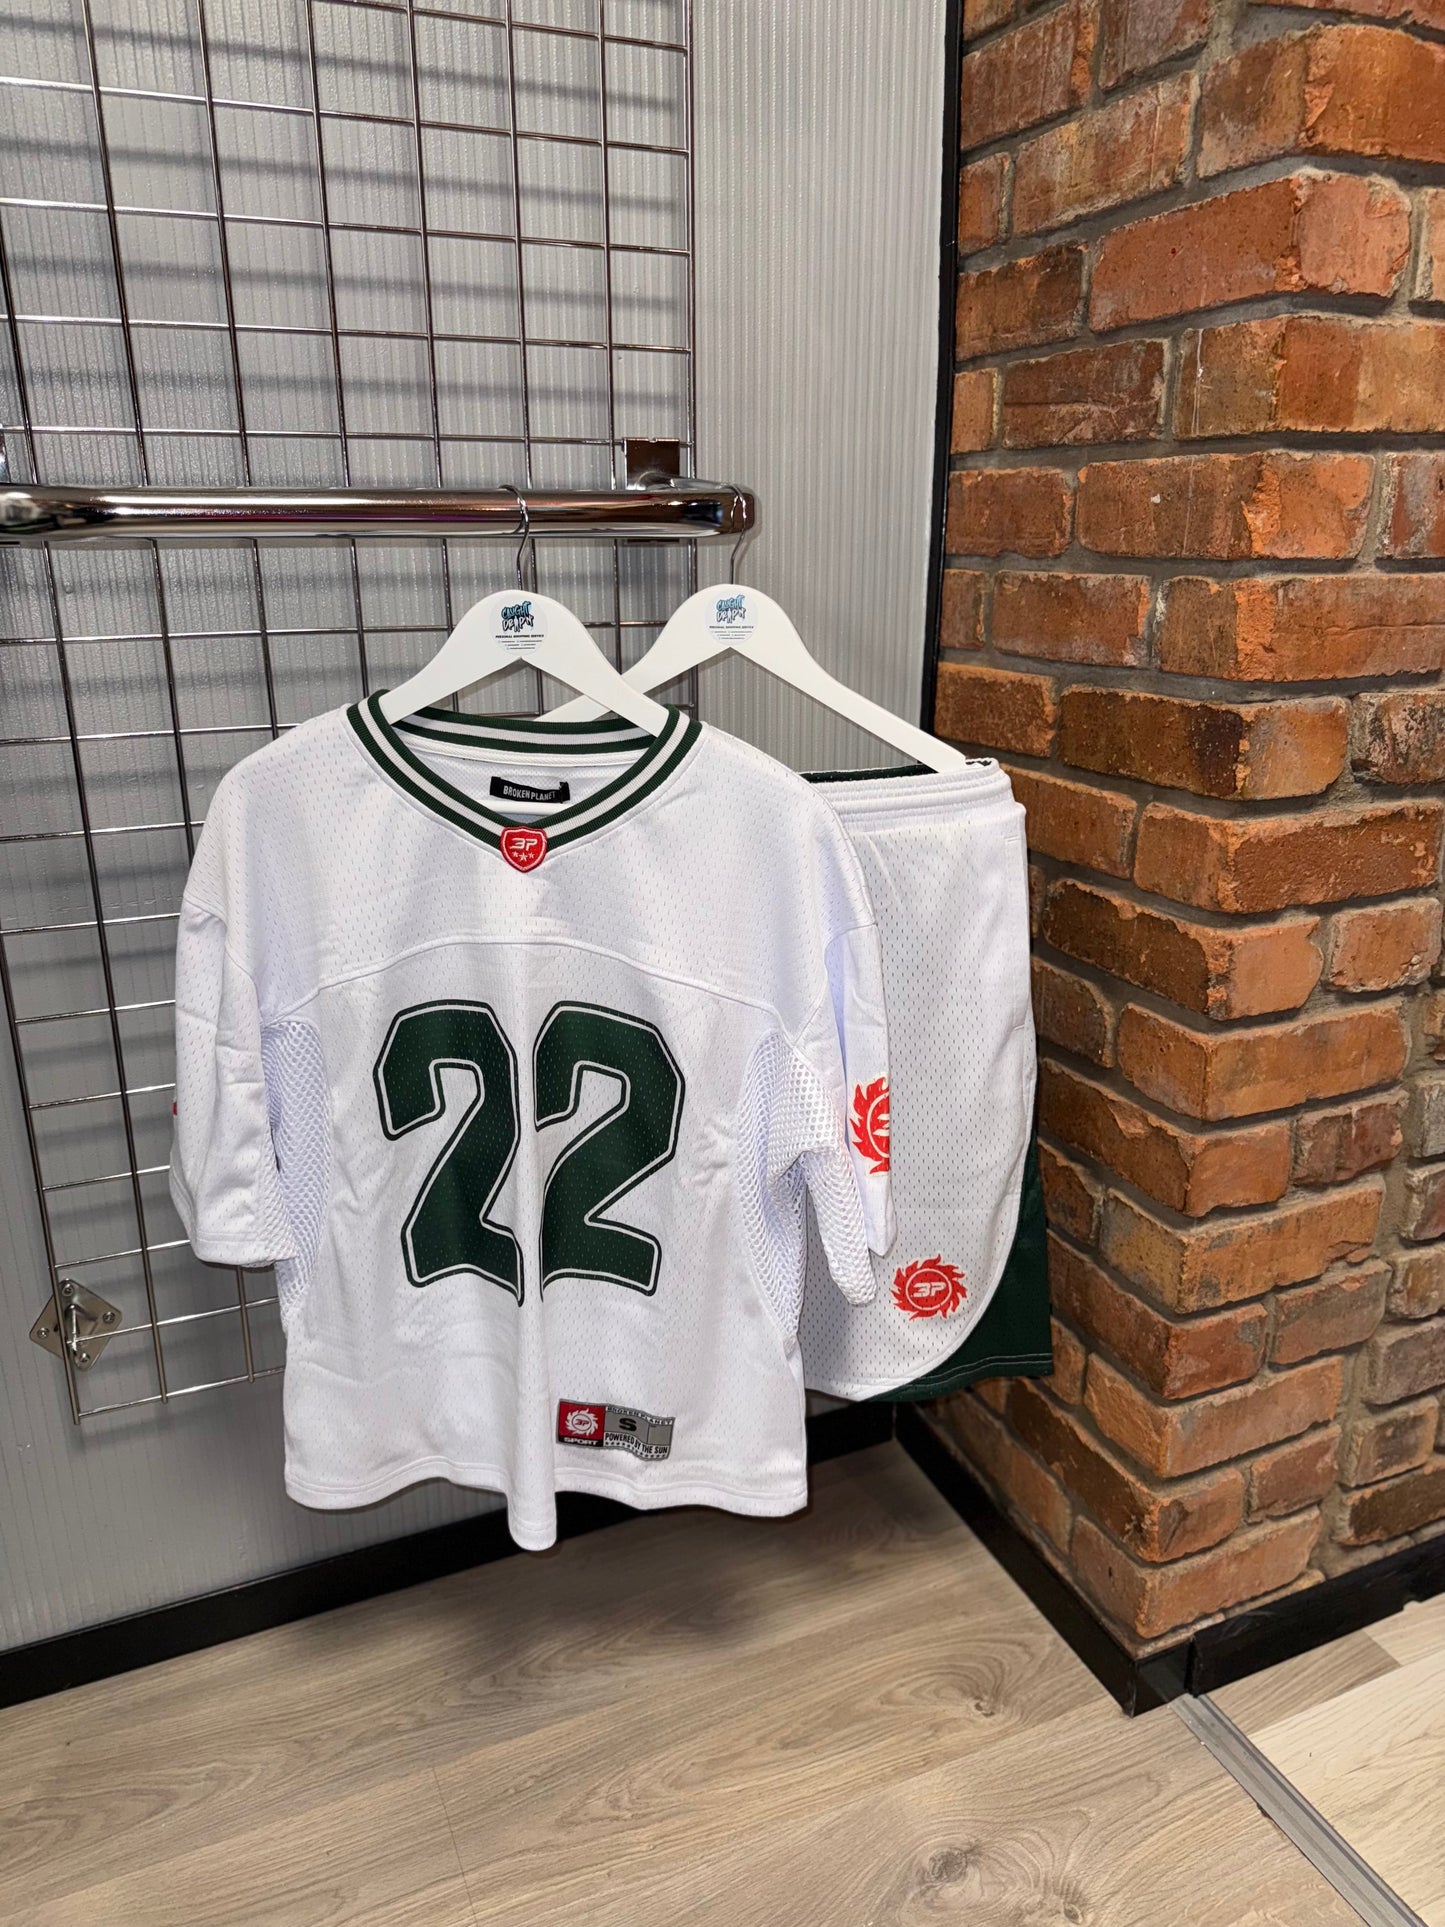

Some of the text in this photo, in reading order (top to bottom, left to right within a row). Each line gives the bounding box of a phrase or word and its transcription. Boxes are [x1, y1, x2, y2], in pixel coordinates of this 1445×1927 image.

[501, 600, 532, 620] CAUGHT
[503, 785, 556, 801] BROKEN PLANET
[373, 999, 685, 1307] 22
[618, 1417, 637, 1432] S
[563, 1437, 599, 1446] SPORT
[605, 1432, 668, 1454] POWERED BY THE SUN
